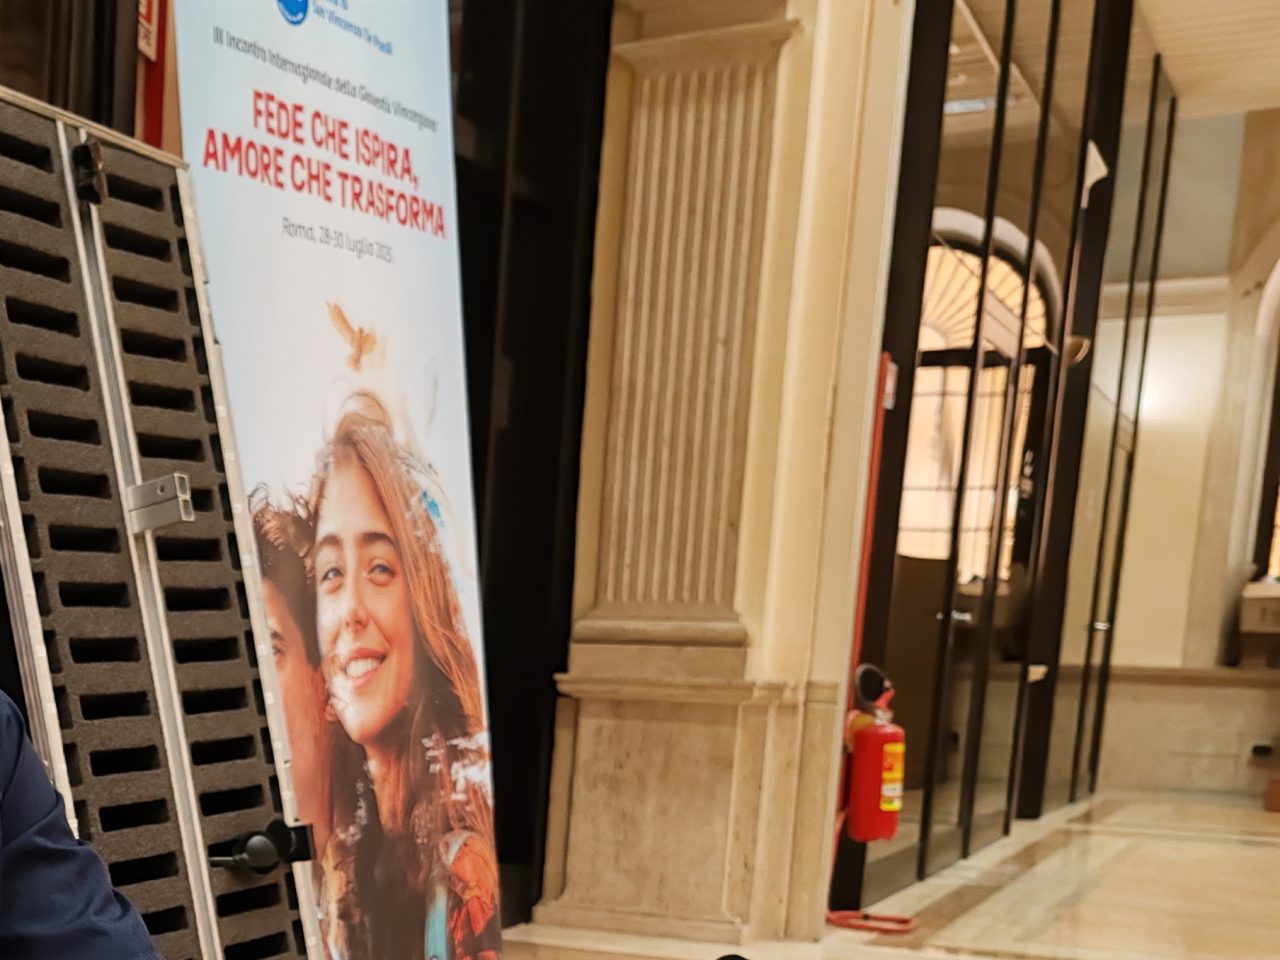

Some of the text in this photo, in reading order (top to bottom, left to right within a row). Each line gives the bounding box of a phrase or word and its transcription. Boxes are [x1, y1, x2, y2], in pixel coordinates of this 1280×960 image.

[226, 30, 267, 62] Incontro
[252, 89, 419, 191] FEDE CHE ISPIRA,
[202, 128, 447, 239] AMORE CHE TRASFORMA
[282, 217, 317, 244] Roma,
